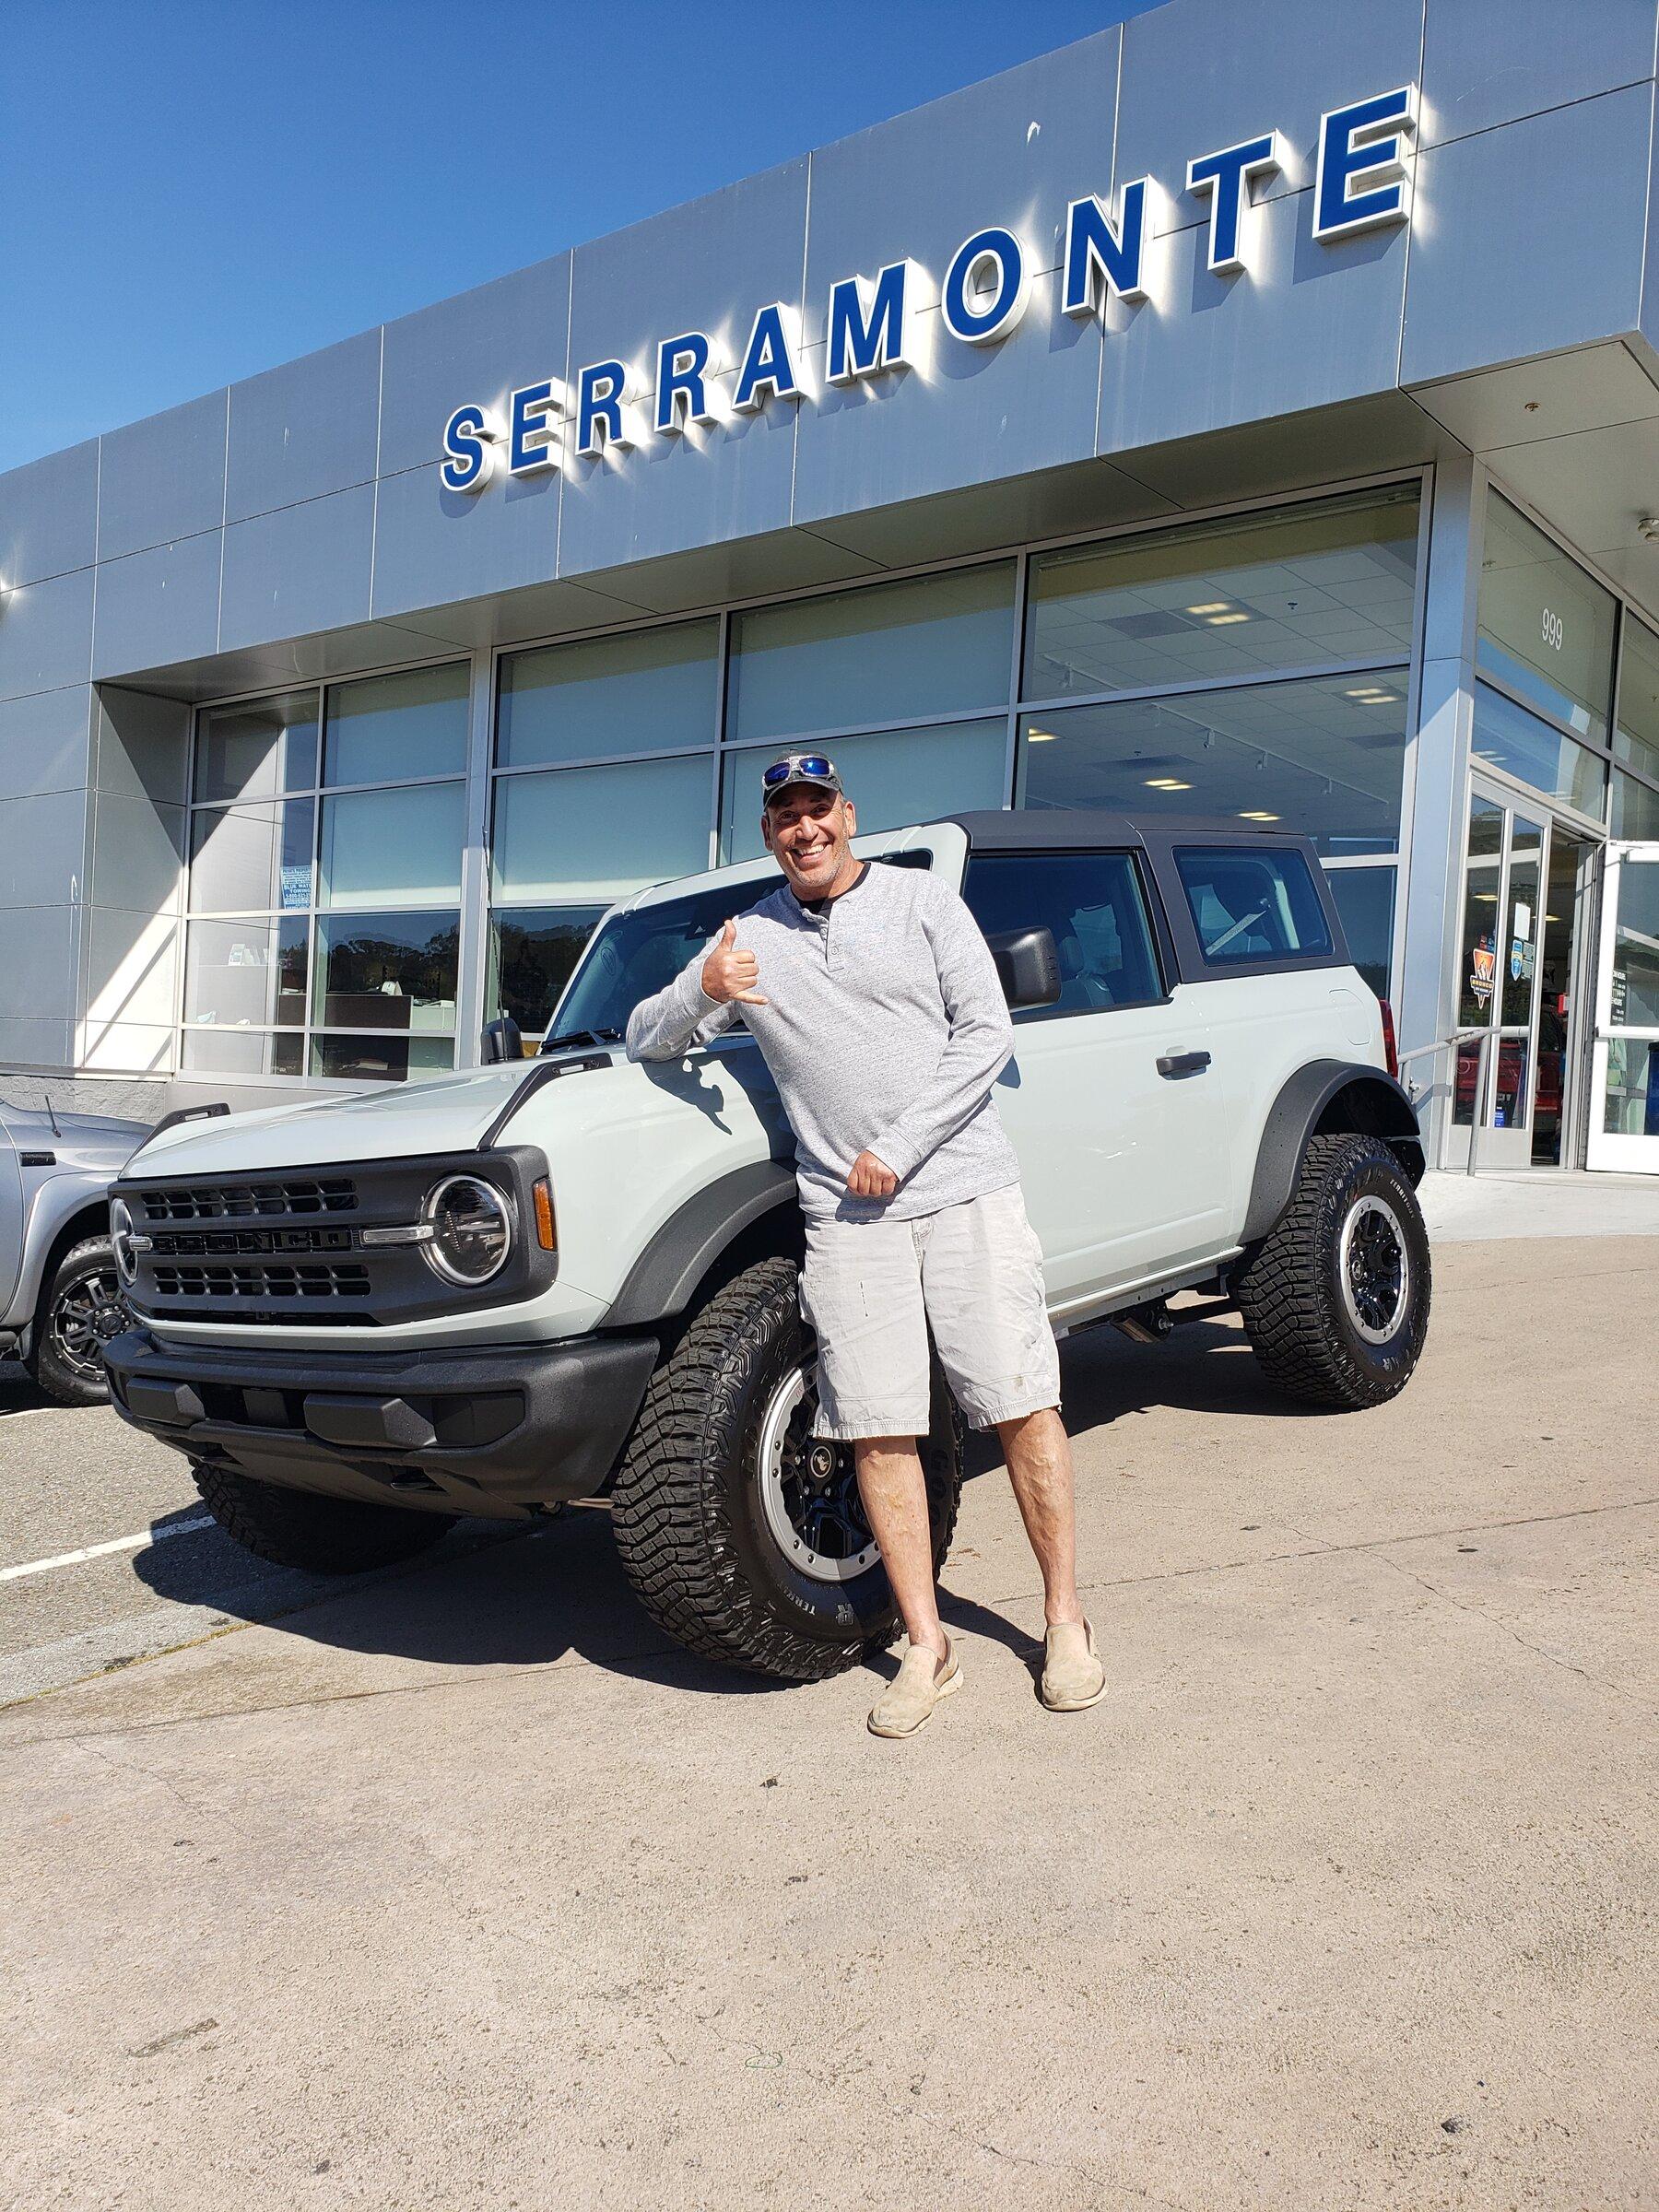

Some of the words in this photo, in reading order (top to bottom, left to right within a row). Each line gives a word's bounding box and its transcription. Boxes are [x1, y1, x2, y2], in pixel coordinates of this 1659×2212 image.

[440, 82, 1418, 495] SERRAMONTE
[1541, 607, 1563, 651] 999
[1471, 979, 1493, 989] BRONCO
